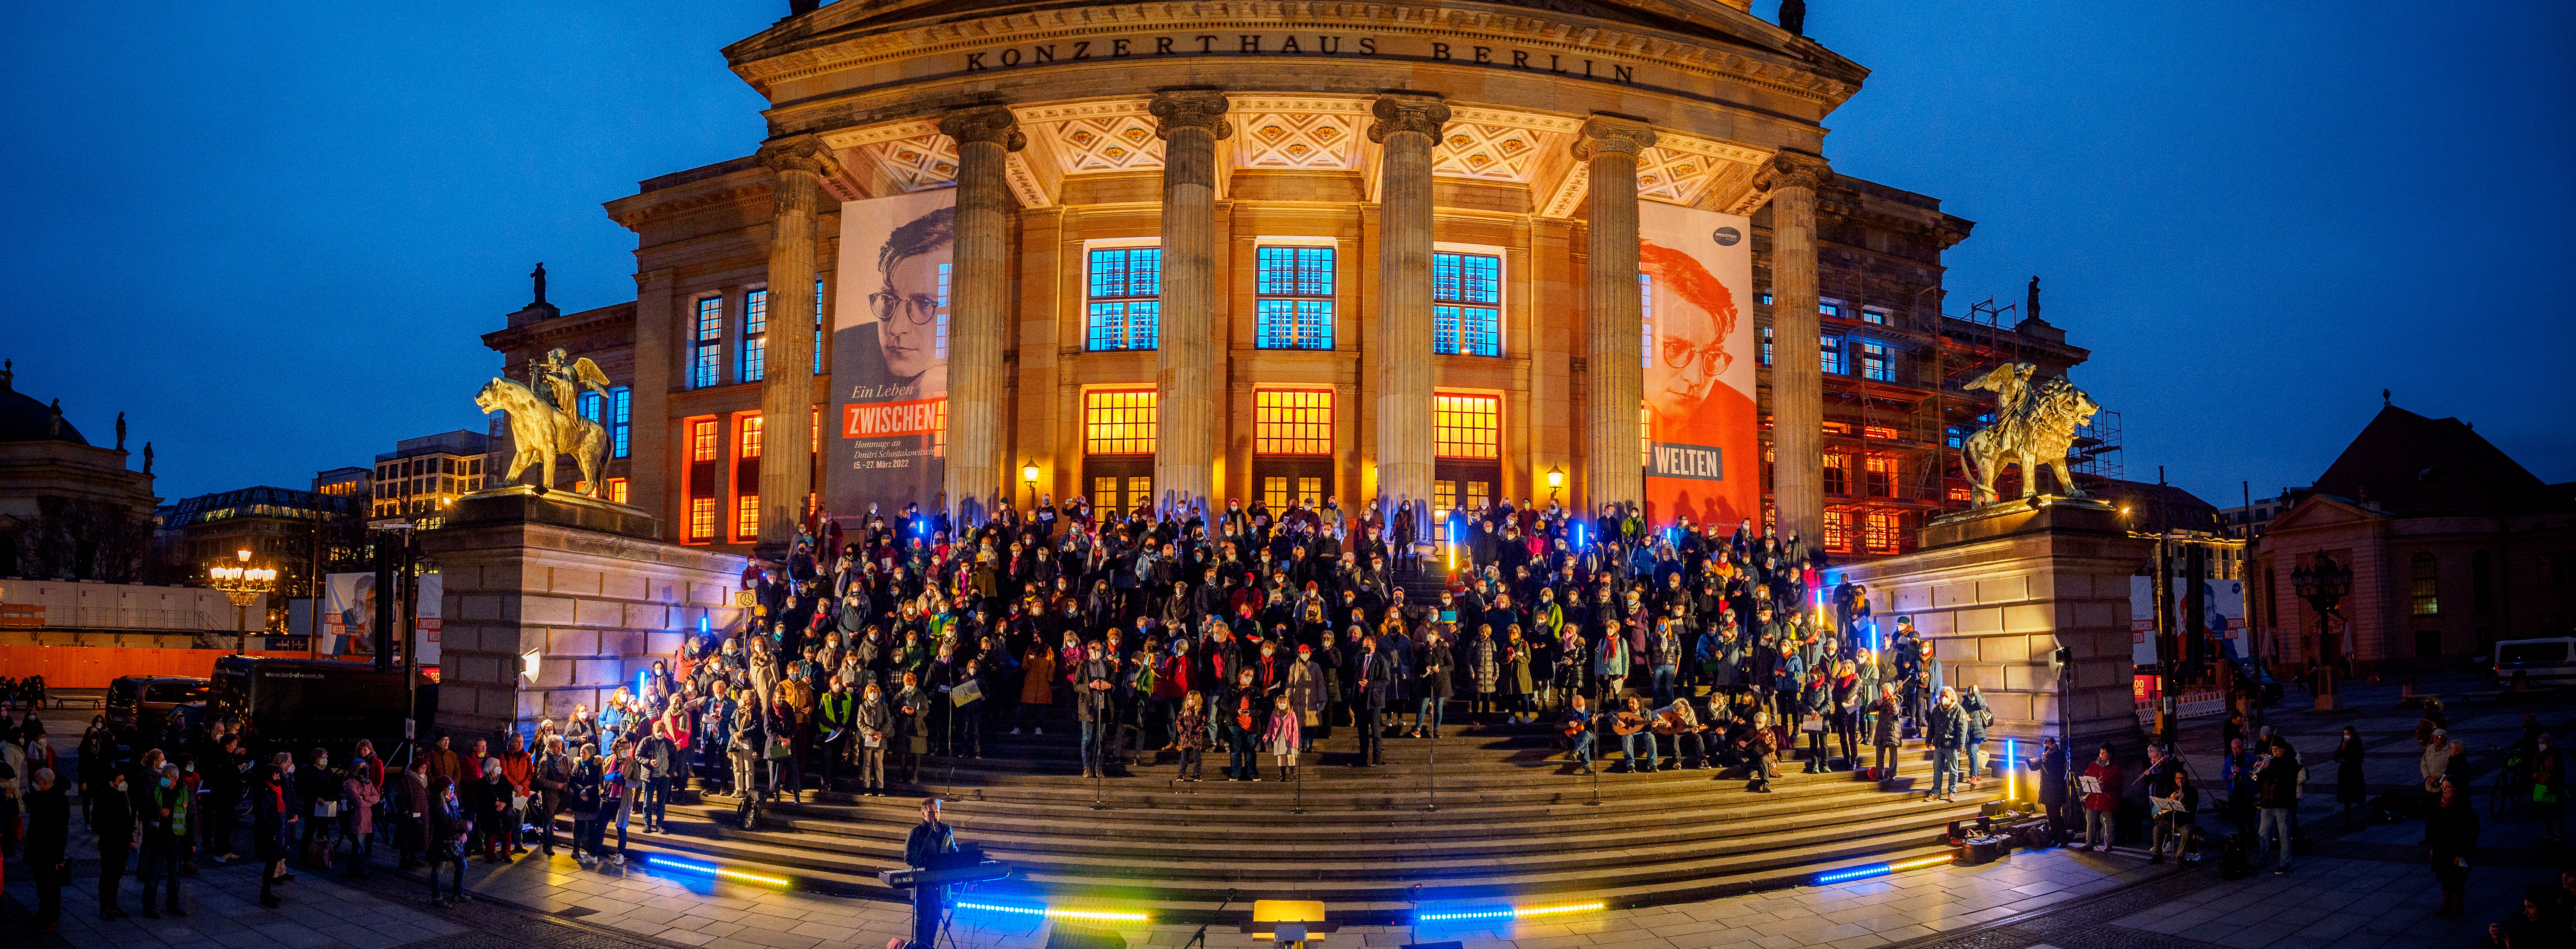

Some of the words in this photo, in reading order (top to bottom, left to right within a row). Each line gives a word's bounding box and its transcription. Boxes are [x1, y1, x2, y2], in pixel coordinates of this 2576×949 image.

[967, 35, 1377, 72] KONZERTHAUS
[1433, 42, 1634, 85] BERLIN
[851, 386, 873, 398] Ein
[876, 383, 913, 397] Leben
[850, 403, 936, 434] ZWISCHEN
[854, 441, 890, 449] Hommage
[879, 447, 934, 458] Schostakowitsch
[876, 460, 892, 469] März
[893, 460, 909, 468] 2022
[1655, 447, 1717, 477] WELTEN
[419, 619, 440, 628] ZWISCHEN
[2132, 621, 2152, 630] ZWISCHEN
